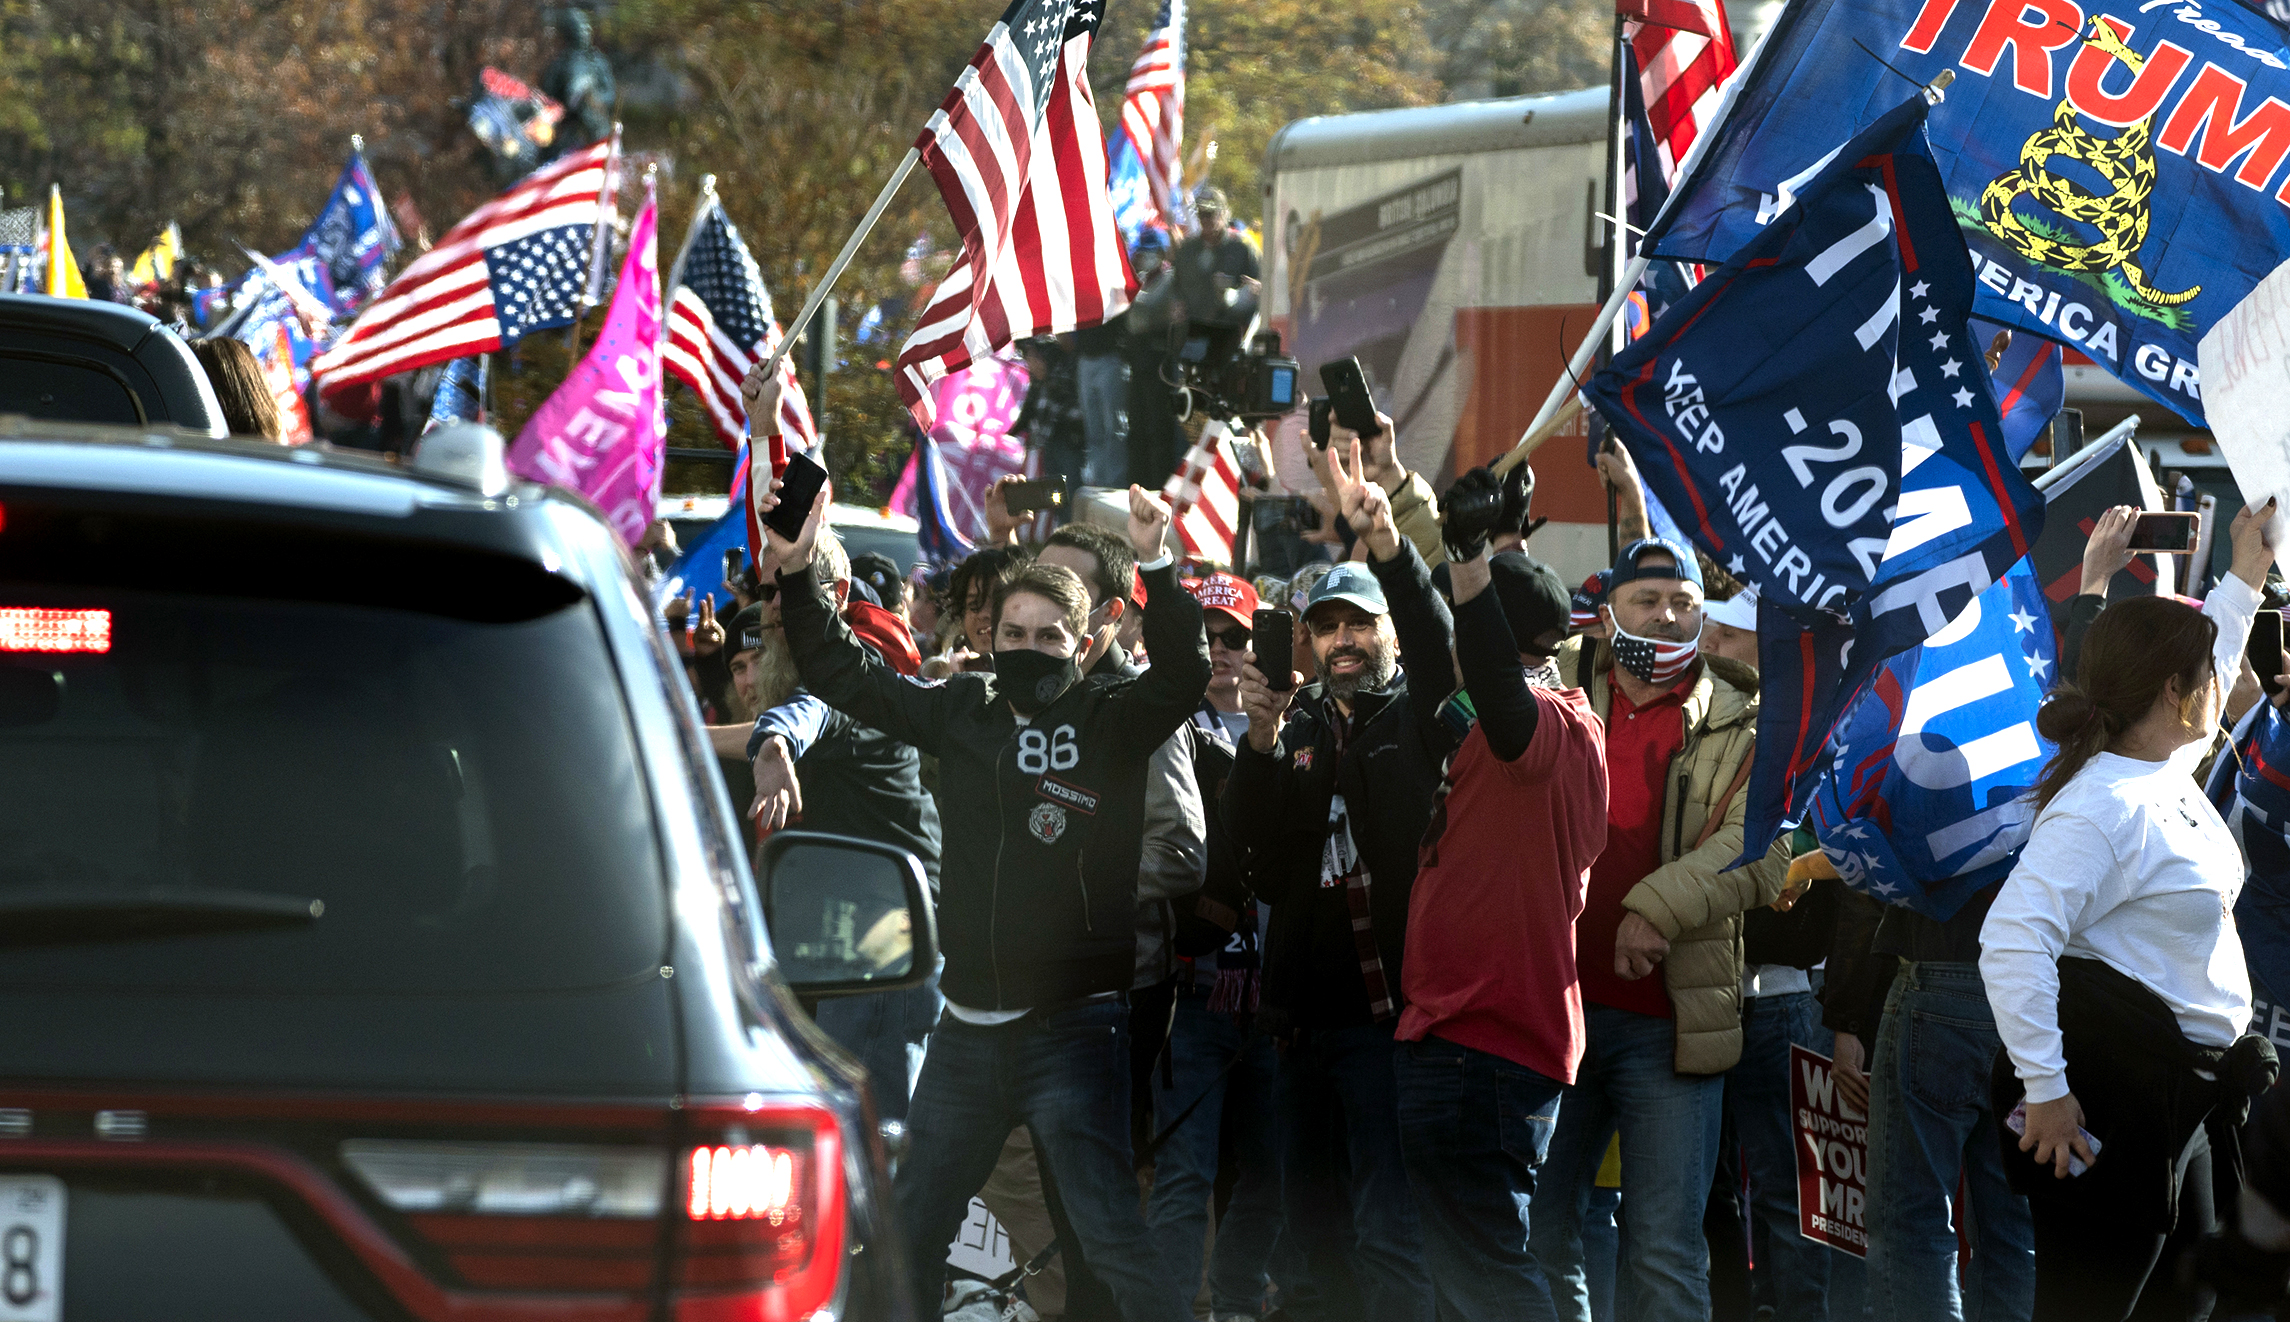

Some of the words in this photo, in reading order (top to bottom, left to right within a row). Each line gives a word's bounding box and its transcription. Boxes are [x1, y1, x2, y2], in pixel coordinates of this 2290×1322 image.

[1900, 0, 2290, 208] RUM
[1967, 249, 2118, 361] ERICA
[2135, 343, 2200, 399] GR
[1664, 357, 1725, 454] KEEP
[1719, 462, 1853, 626] AMERIC
[1202, 575, 1233, 588] KEEP
[1017, 724, 1080, 775] 86
[1042, 780, 1097, 808] MOSSIMO
[1799, 1107, 1868, 1146] SUPPOR
[1819, 1176, 1866, 1229] MR
[1811, 1213, 1869, 1248] PRESIDEN
[2, 1223, 41, 1307] 8
